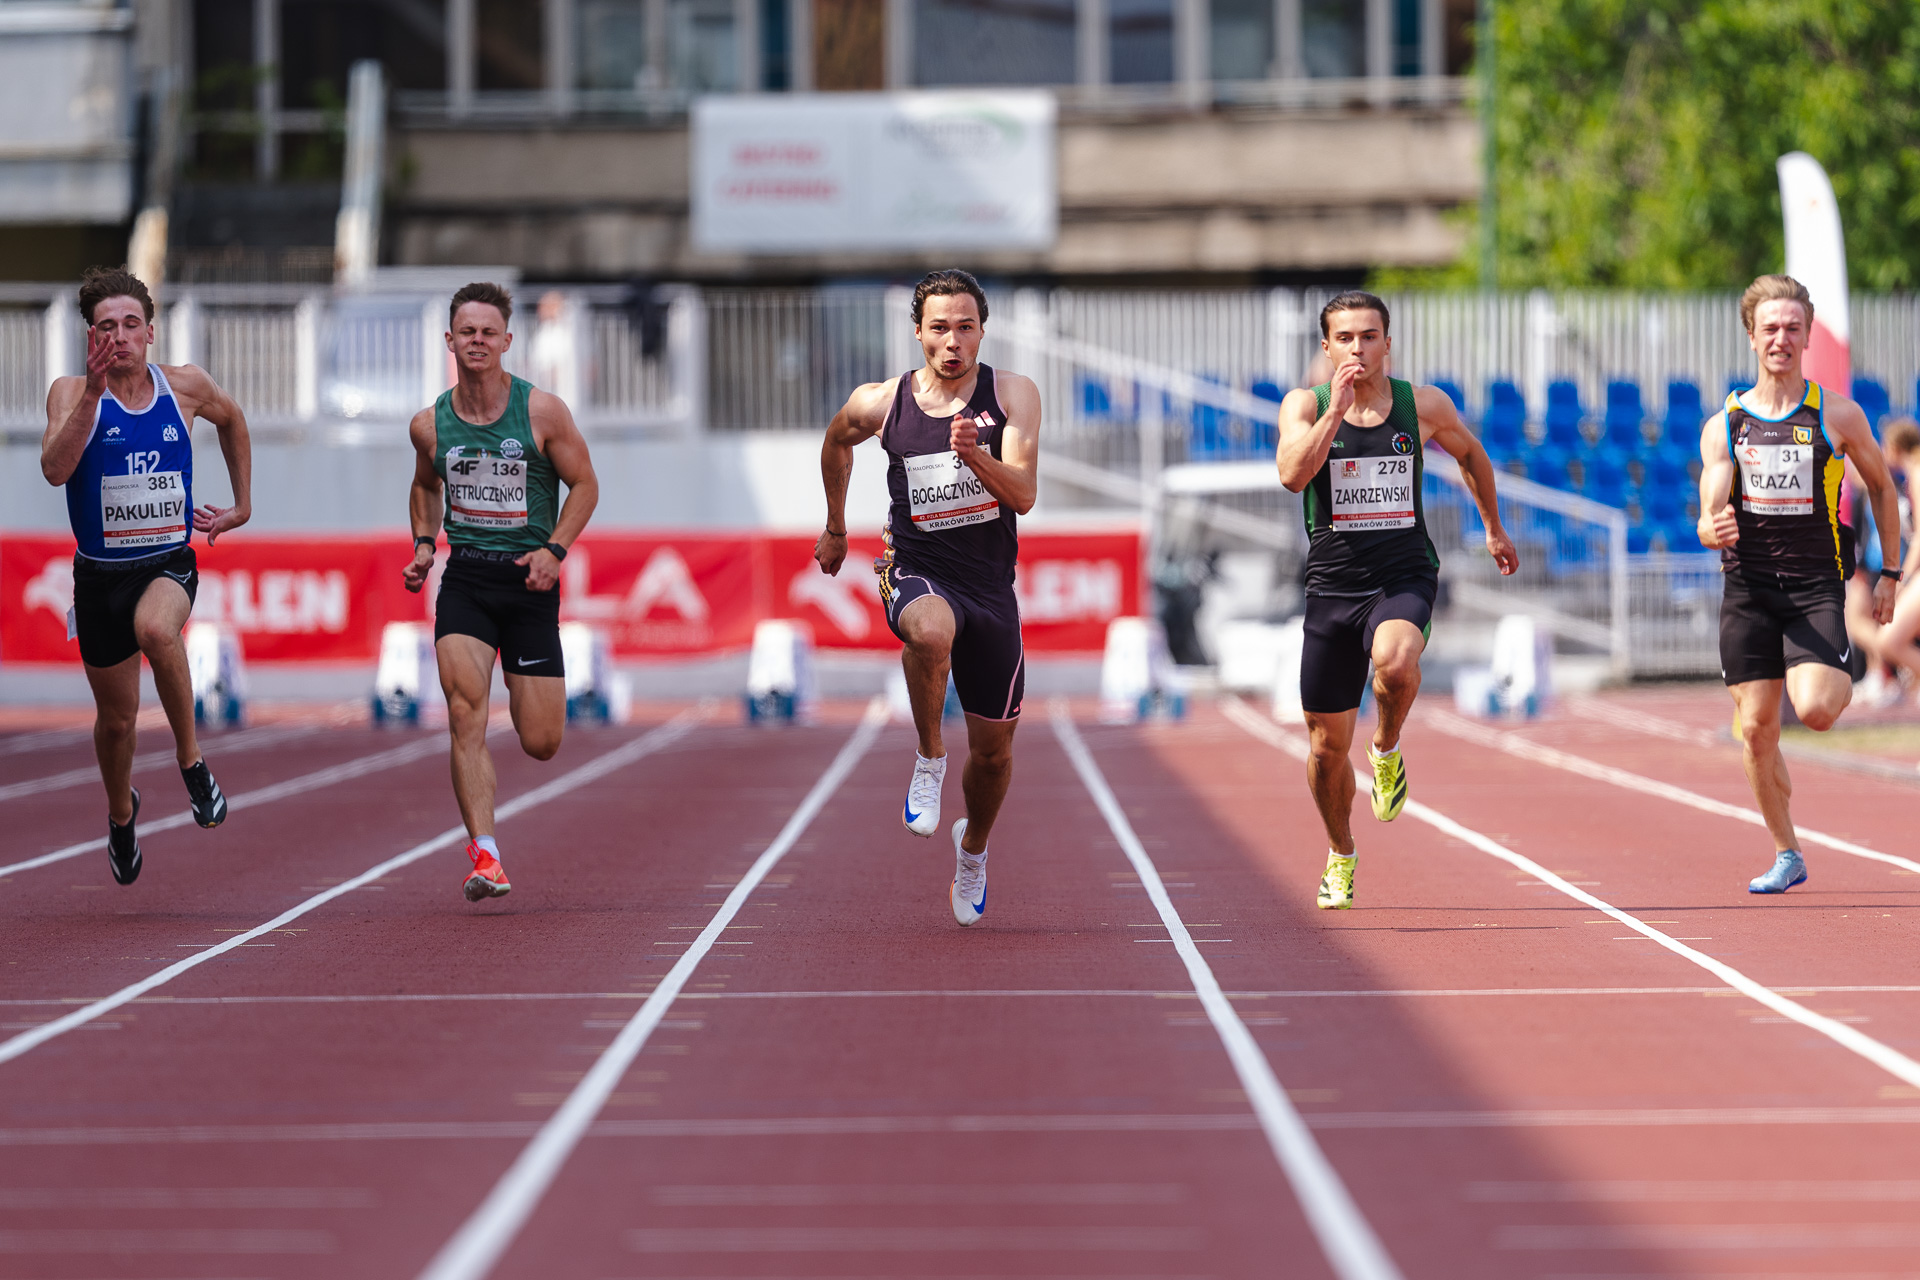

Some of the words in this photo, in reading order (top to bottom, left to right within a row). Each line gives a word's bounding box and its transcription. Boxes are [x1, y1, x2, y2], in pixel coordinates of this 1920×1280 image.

[446, 445, 466, 457] 4F
[1782, 450, 1800, 462] 31
[125, 450, 160, 475] 152
[451, 460, 480, 475] 4F
[492, 462, 520, 476] 136
[913, 463, 944, 472] MAŁOPOLSKA
[1378, 460, 1407, 475] 278
[148, 476, 176, 490] 381
[1750, 474, 1800, 489] GLAZA
[450, 483, 523, 502] PETRUCZEŃKO
[1335, 486, 1409, 504] ZAKRZEWSKI
[105, 500, 182, 522] PAKULIEV
[464, 516, 492, 525] KRAKÓW
[929, 517, 965, 528] KRAKÓW
[966, 514, 984, 522] 2025
[120, 536, 154, 545] KRAKÓW
[460, 547, 499, 561] NIKE
[192, 568, 350, 633] RLEN
